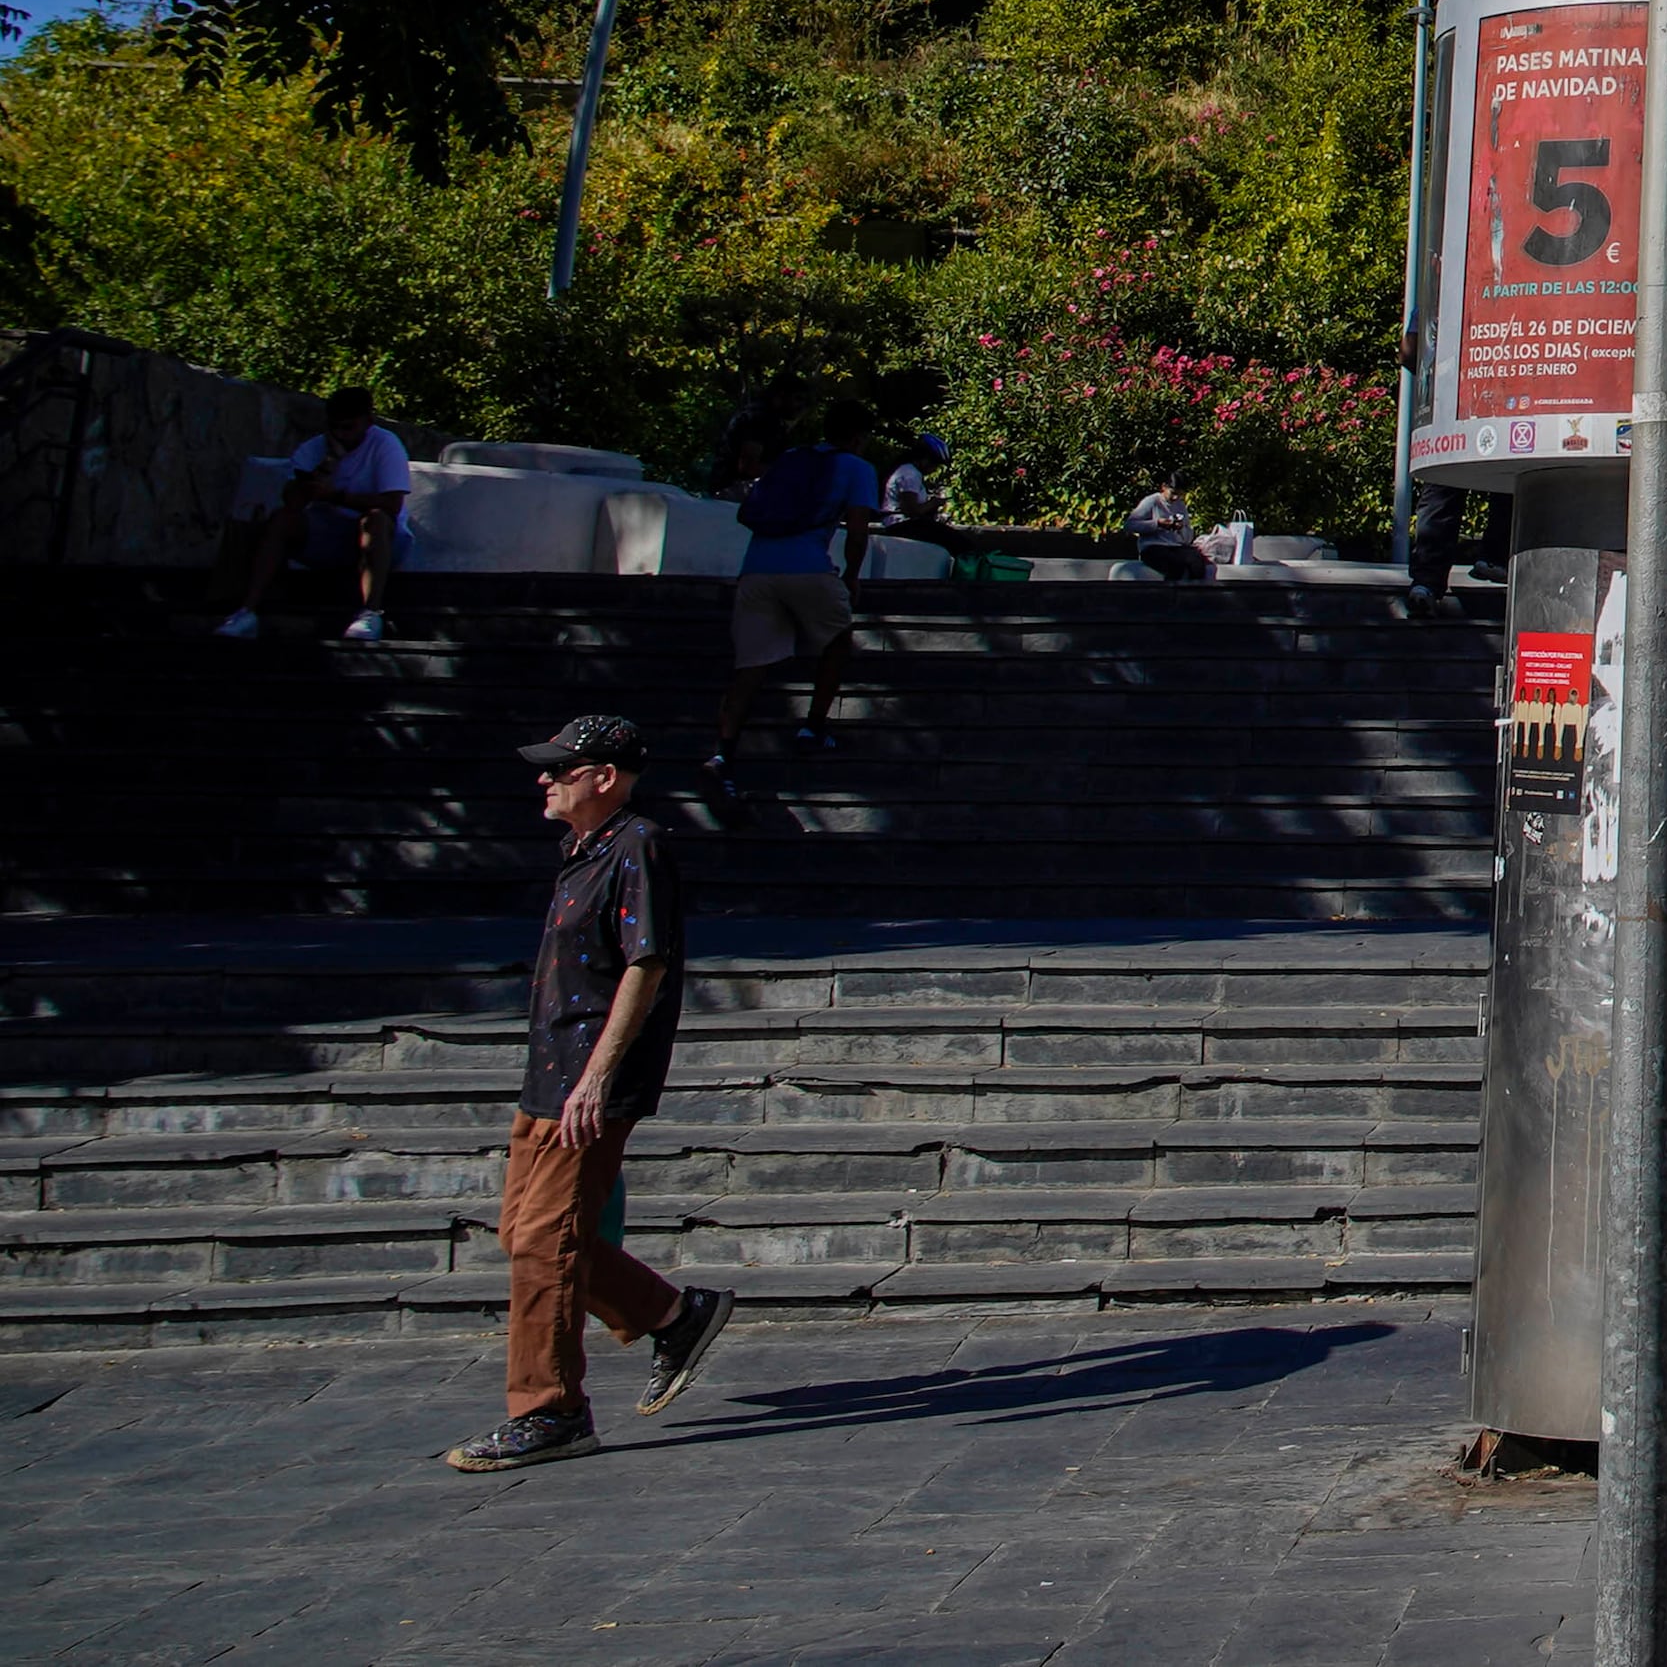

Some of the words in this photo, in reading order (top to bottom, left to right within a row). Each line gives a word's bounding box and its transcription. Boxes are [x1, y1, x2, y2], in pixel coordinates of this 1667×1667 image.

[1496, 49, 1553, 74] PASES
[1558, 47, 1649, 68] MATINA
[1495, 82, 1517, 102] DE
[1521, 76, 1618, 100] NAVIDAD
[1522, 138, 1612, 267] 5
[1606, 242, 1622, 264] €
[1482, 287, 1491, 299] A
[1493, 282, 1538, 298] PARTIR
[1541, 281, 1562, 296] DE
[1565, 280, 1596, 295] LAS
[1470, 323, 1508, 341] DESDE
[1510, 321, 1525, 337] EL
[1528, 320, 1548, 336] 26
[1551, 320, 1573, 335] DE
[1576, 318, 1637, 335] DICIEM
[1469, 345, 1511, 362] TODOS
[1513, 343, 1540, 359] LOS
[1467, 363, 1495, 379] HASTA
[1498, 364, 1509, 377] EL
[1509, 364, 1517, 377] 5
[1518, 363, 1534, 377] DE
[1536, 362, 1577, 376] ENERO
